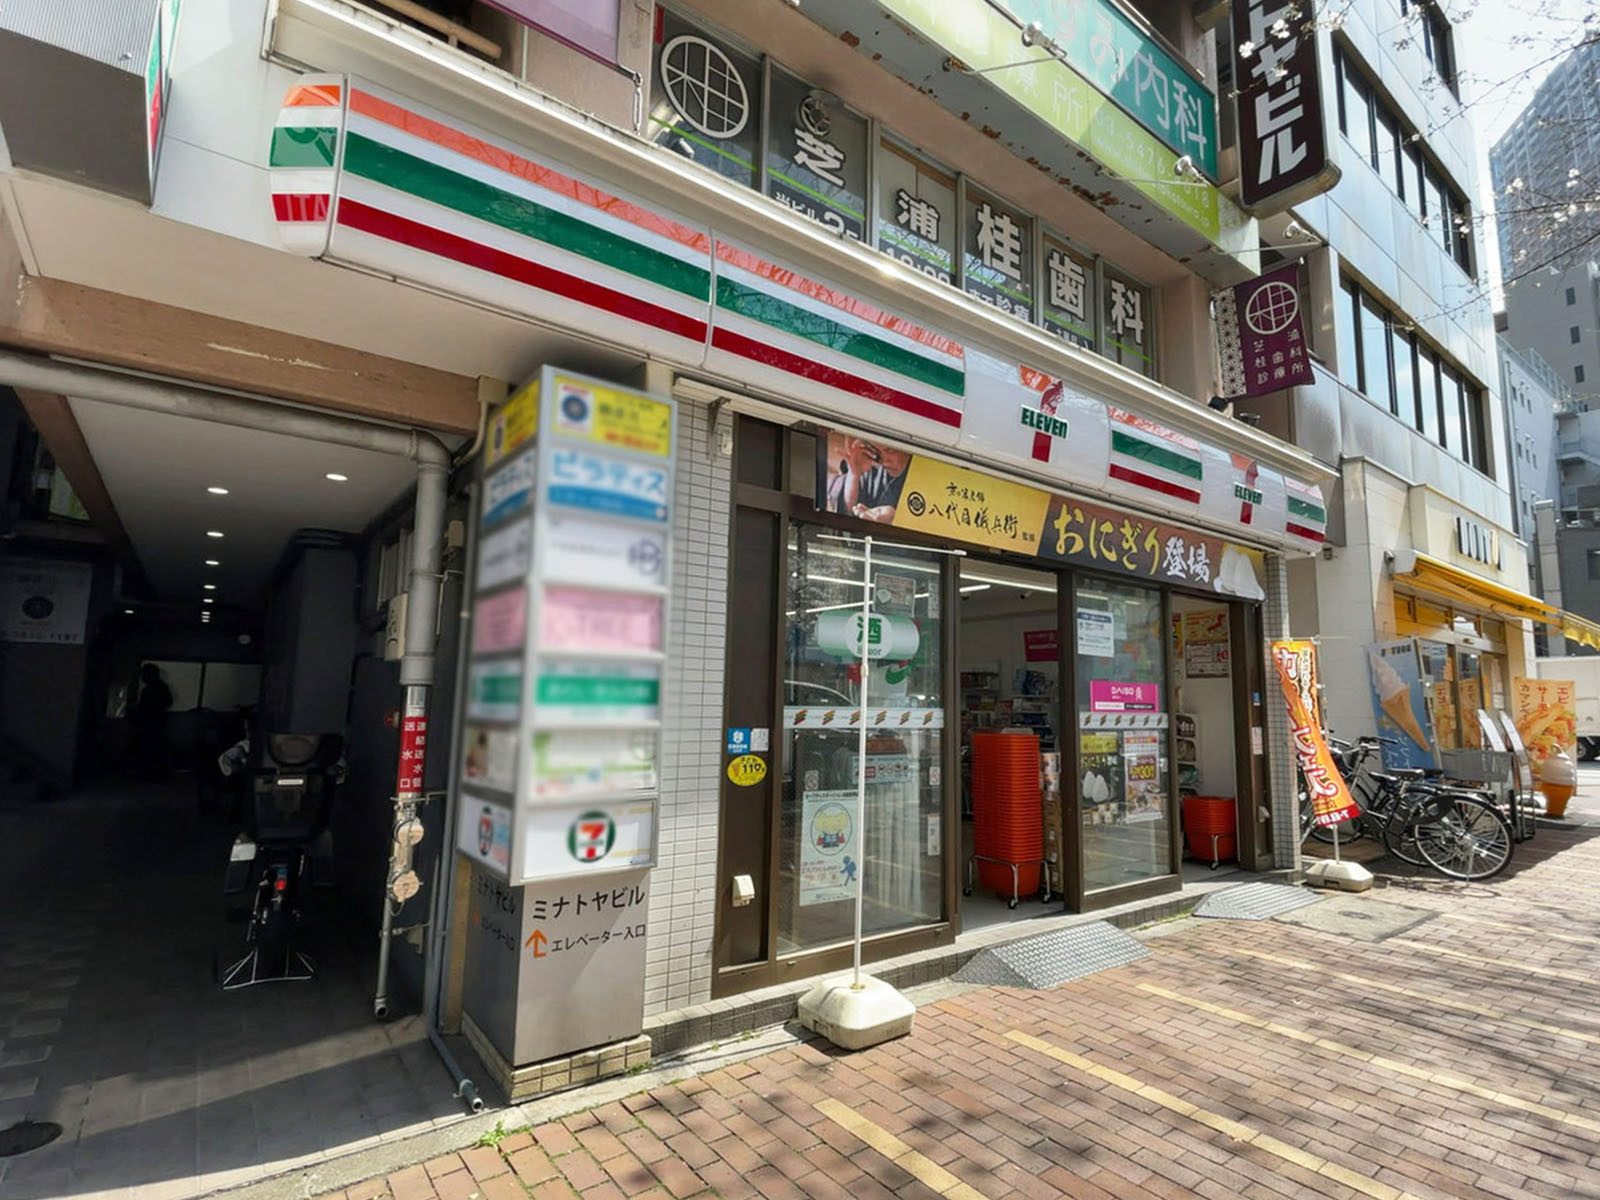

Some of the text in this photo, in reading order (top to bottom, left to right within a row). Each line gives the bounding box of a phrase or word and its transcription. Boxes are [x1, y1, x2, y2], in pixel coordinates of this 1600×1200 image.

[1248, 0, 1308, 185] トヤビル
[856, 616, 882, 644] 酒
[532, 886, 646, 920] ミナトヤビル
[551, 923, 647, 952] エレベーター入口
